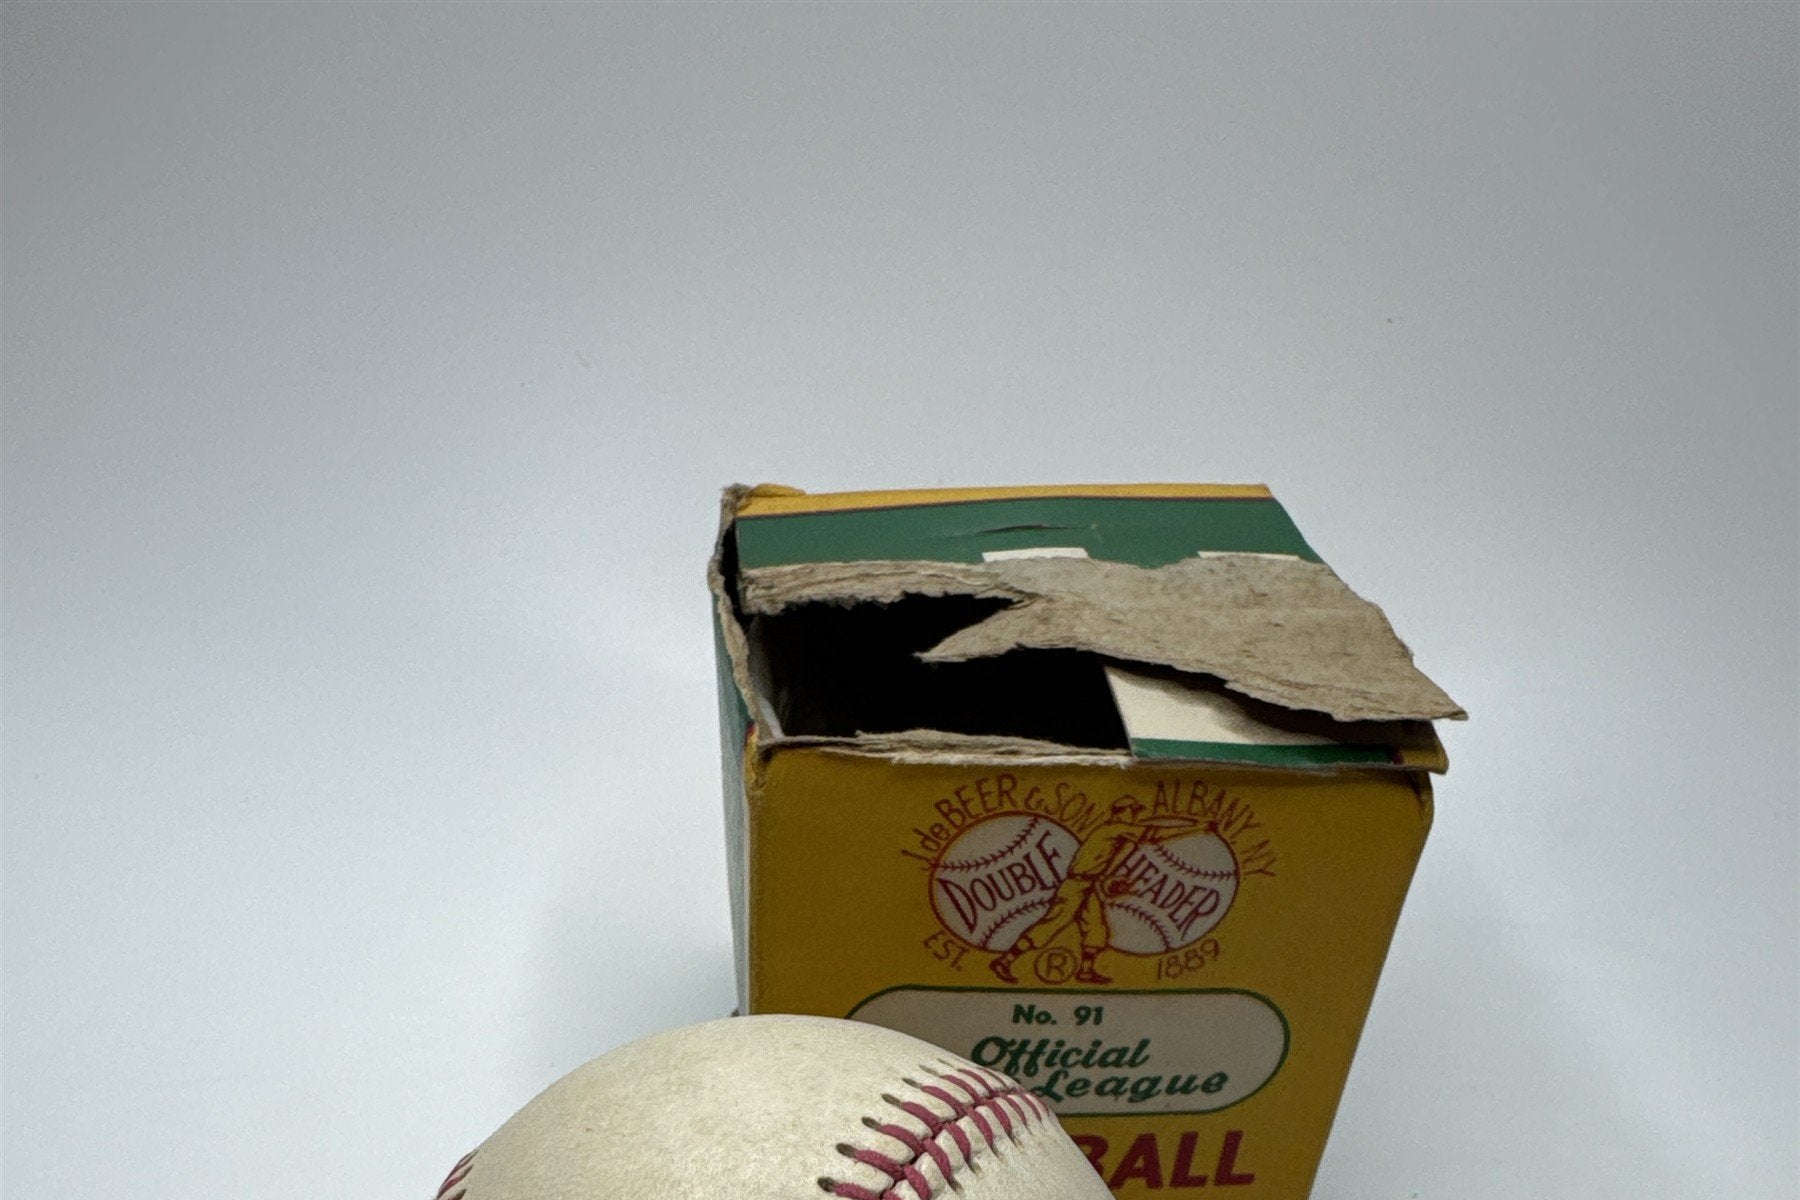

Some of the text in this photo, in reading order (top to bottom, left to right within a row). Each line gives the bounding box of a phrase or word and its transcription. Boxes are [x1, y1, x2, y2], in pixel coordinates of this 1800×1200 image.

[1046, 781, 1108, 835] SON
[937, 830, 1220, 941] DOUBLE HEADER
[923, 933, 965, 971] EST.
[1157, 938, 1220, 980] 1889
[1012, 1003, 1104, 1026] No. 91
[970, 1035, 1151, 1077] Official
[1030, 1068, 1230, 1102] League
